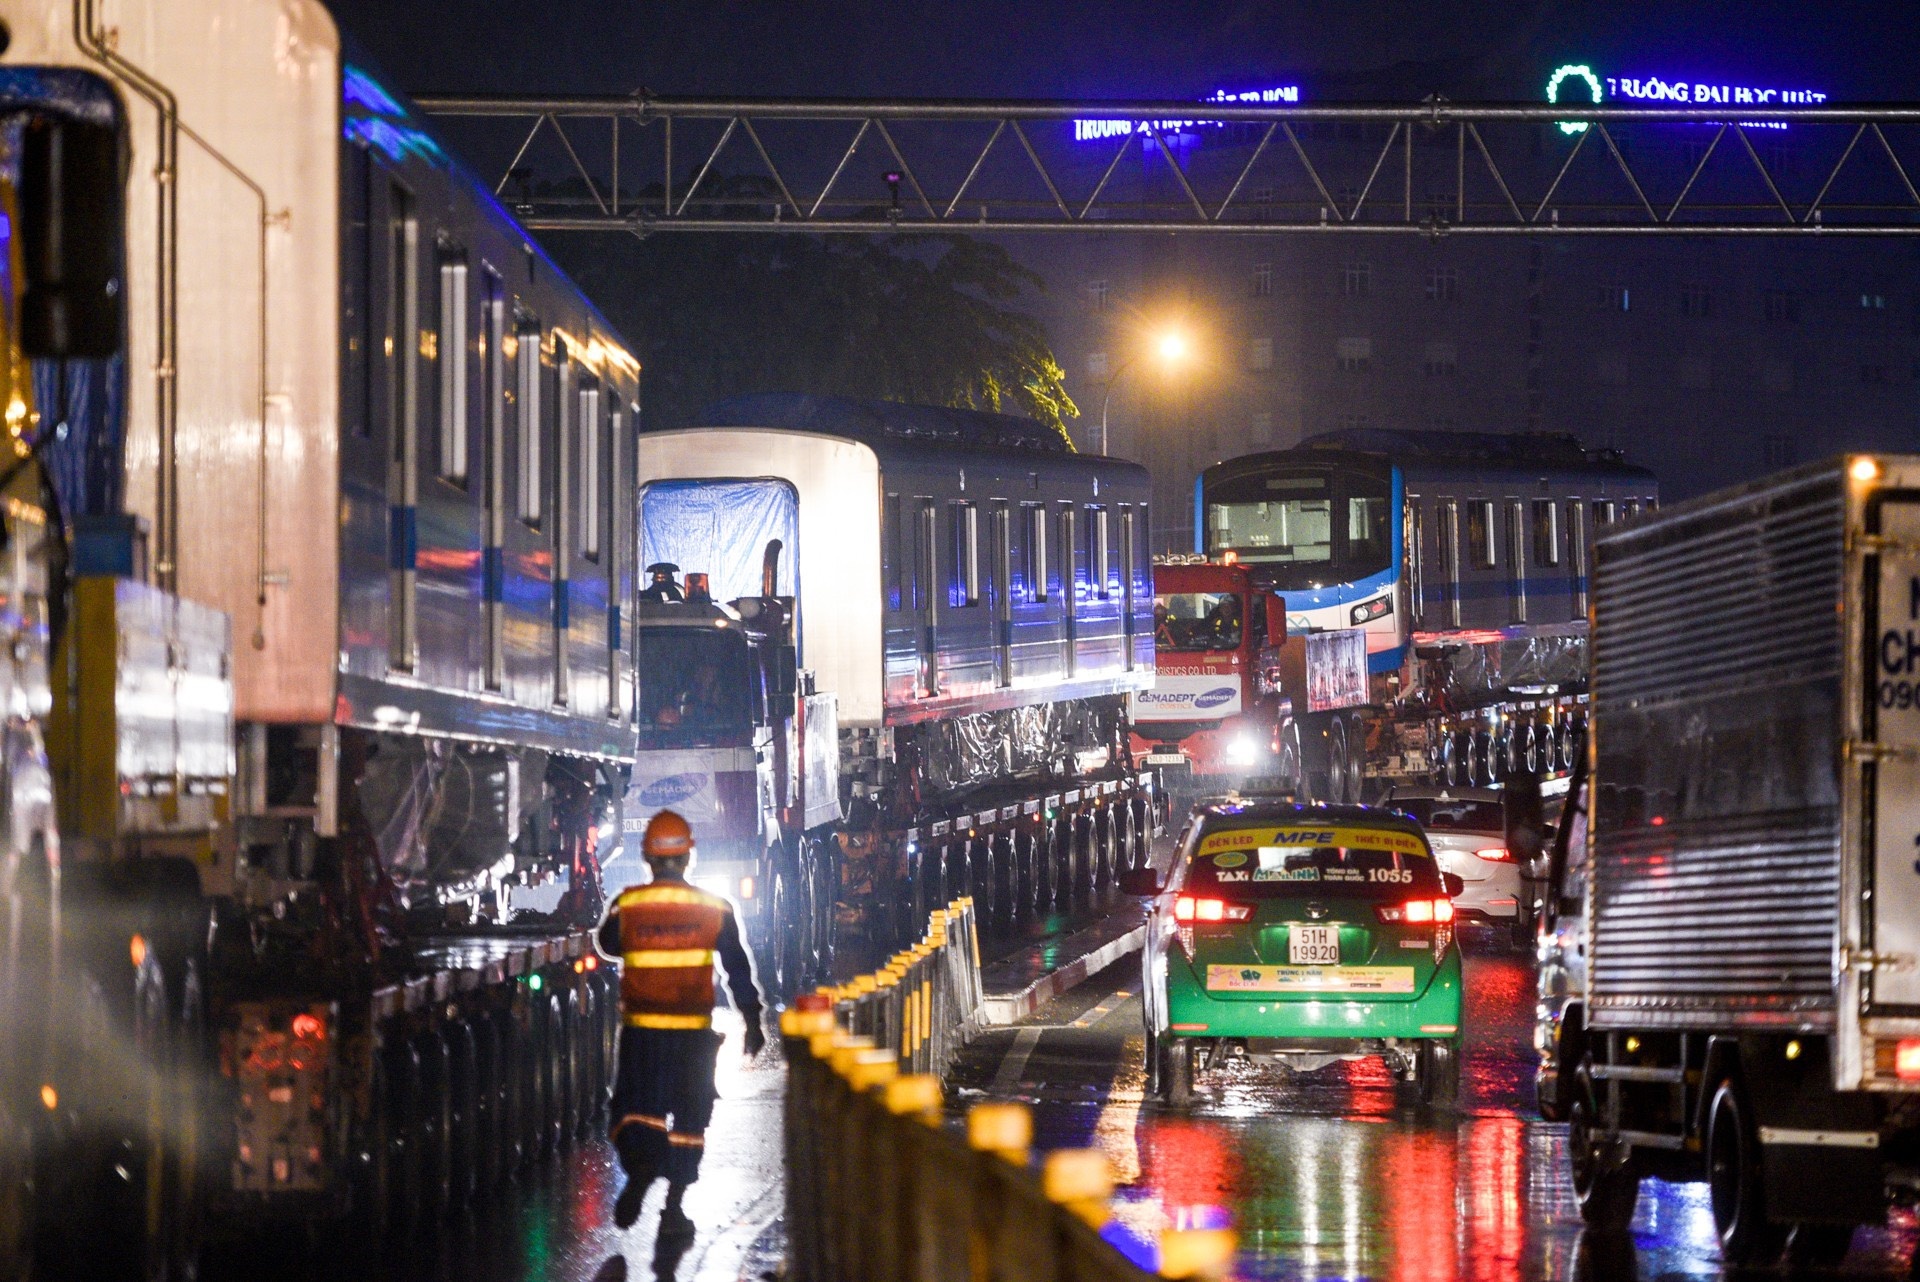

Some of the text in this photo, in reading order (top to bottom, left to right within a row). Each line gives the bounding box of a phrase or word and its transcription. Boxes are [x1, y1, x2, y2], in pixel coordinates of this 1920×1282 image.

[1138, 693, 1195, 702] GEMADEPT
[1233, 836, 1254, 845] LED
[1273, 832, 1336, 843] MPE
[1368, 868, 1413, 883] 1055
[1302, 930, 1327, 944] 51H
[1293, 946, 1337, 960] 199.20
